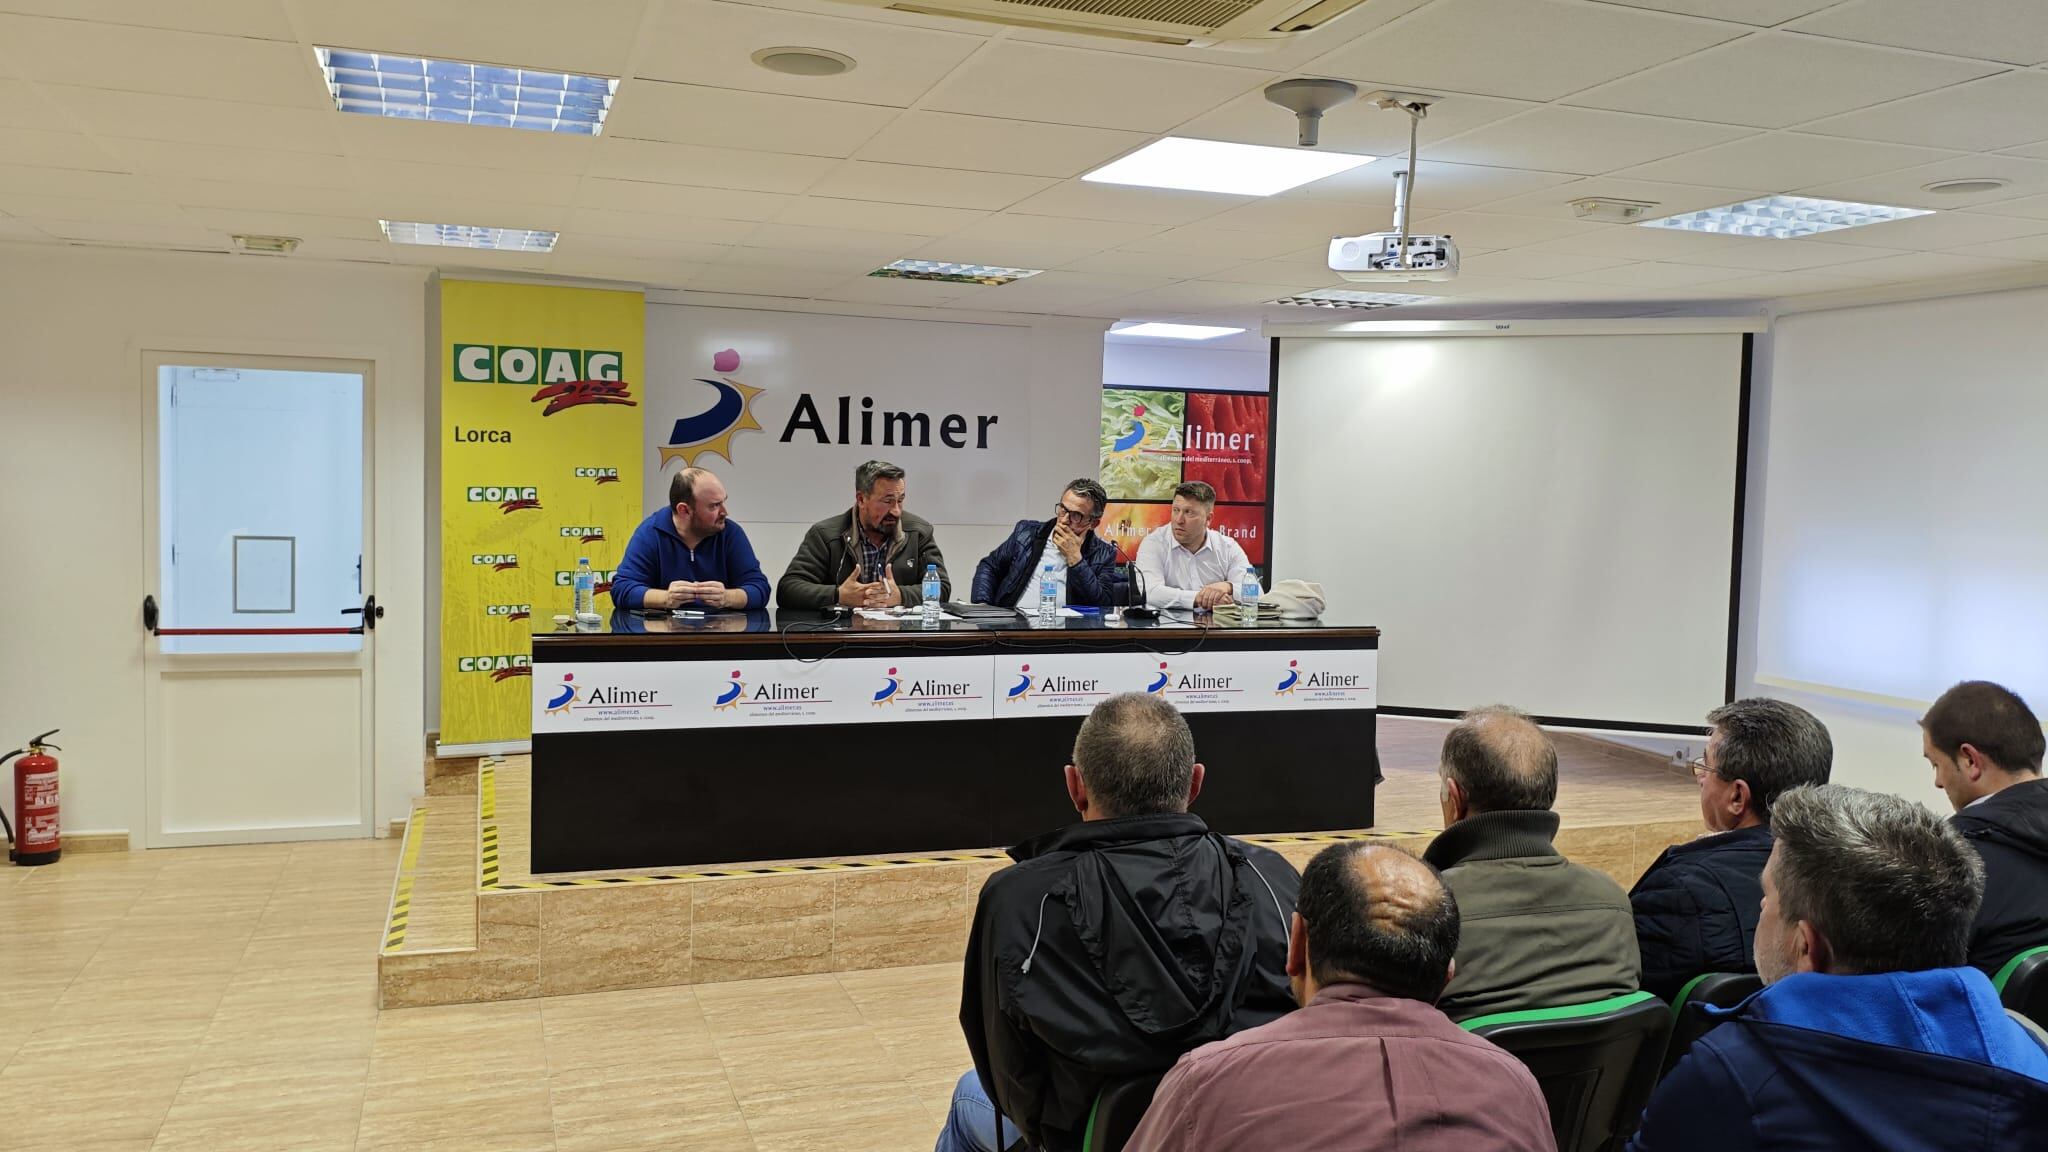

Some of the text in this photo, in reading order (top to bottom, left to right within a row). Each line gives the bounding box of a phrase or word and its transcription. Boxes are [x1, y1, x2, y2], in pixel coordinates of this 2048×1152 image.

[458, 346, 619, 384] COAG
[779, 393, 999, 449] Alimer
[455, 426, 512, 443] Lorca
[1160, 424, 1255, 451] Alimer
[575, 468, 617, 477] COAG
[468, 487, 537, 501] COAG
[561, 527, 603, 536] COAG
[1104, 524, 1257, 538] Alimer Brand
[473, 554, 517, 564] COAG
[487, 604, 530, 615] COAG
[459, 655, 528, 671] COAG
[1041, 676, 1099, 692] Alimer
[1178, 674, 1233, 689] Alimer
[1307, 672, 1359, 687] Alimer
[588, 686, 658, 704] Alimer
[754, 683, 819, 700] Alimer
[909, 680, 970, 696] Alimer
